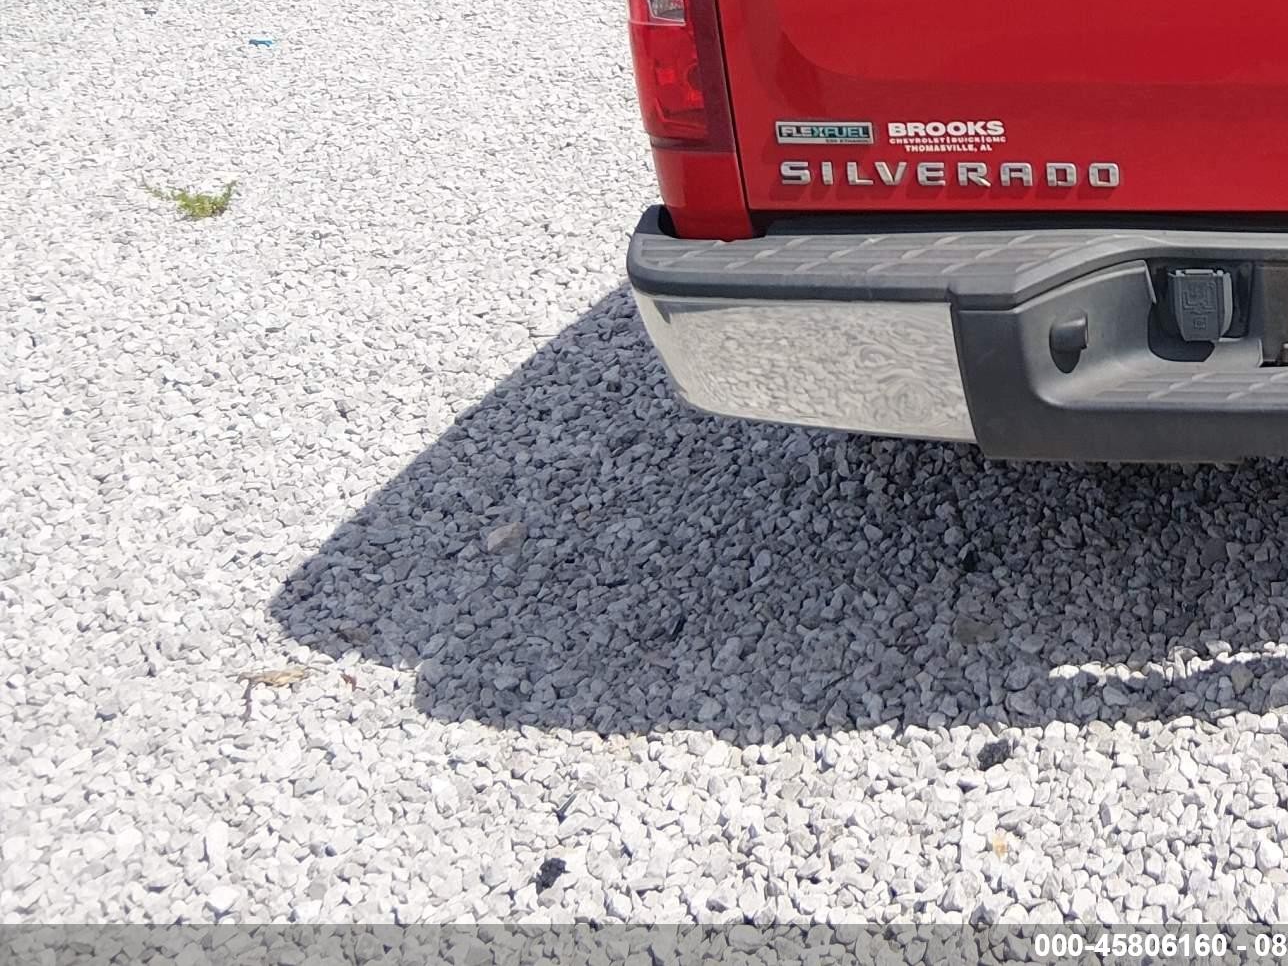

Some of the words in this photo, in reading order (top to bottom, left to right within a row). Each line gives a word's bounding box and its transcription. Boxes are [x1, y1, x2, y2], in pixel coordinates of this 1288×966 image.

[780, 125, 869, 138] FLEXFUEL
[887, 120, 1005, 137] BROOKS
[979, 143, 993, 151] AL
[780, 161, 1121, 187] SILVERADO
